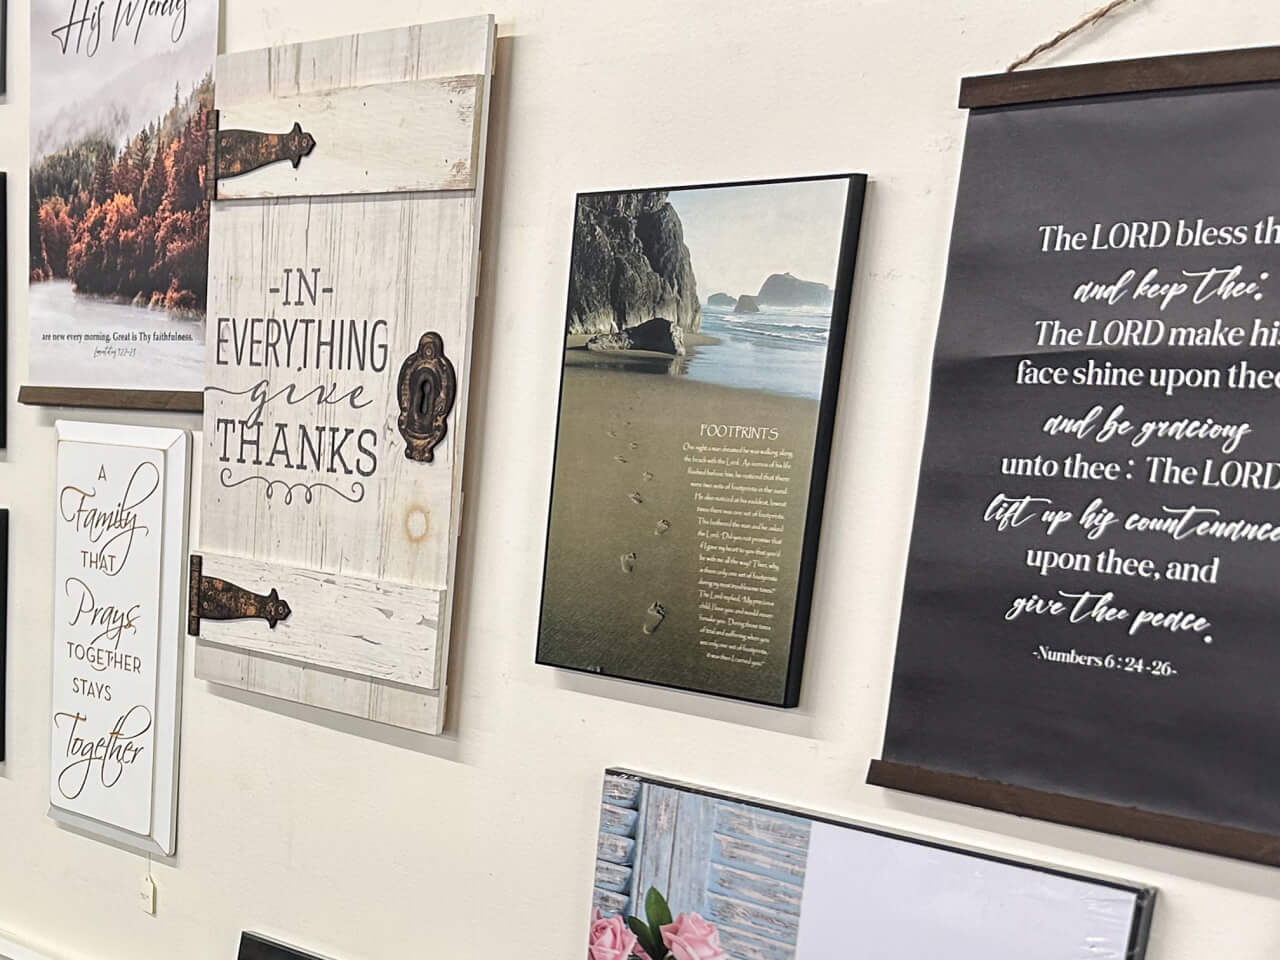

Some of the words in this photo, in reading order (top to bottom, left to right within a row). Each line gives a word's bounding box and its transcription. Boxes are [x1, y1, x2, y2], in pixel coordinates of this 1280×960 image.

[52, 0, 104, 57] His
[111, 0, 188, 45] Mercy
[1039, 225, 1087, 252] The
[1092, 220, 1171, 250] LORD
[1176, 219, 1248, 247] bless
[1073, 268, 1136, 305] and
[1133, 268, 1188, 312] keep
[41, 333, 52, 342] are
[52, 333, 65, 342] new
[66, 334, 83, 344] every
[112, 331, 131, 342] Great
[131, 332, 137, 342] is
[139, 332, 151, 344] Thy
[152, 331, 194, 342] faithfulness.
[215, 317, 389, 373] EVERYTHING
[1035, 320, 1083, 346] The
[1086, 319, 1165, 347] LORD
[1168, 318, 1245, 347] make
[1250, 318, 1280, 347] hi
[1016, 359, 1069, 385] face
[1072, 359, 1144, 386] shine
[1150, 365, 1220, 396] upon
[204, 379, 374, 430] give
[217, 418, 378, 477] THANKS
[700, 423, 780, 441] FOOTPRINTS
[1043, 405, 1104, 439] and
[1096, 405, 1134, 443] be
[1131, 418, 1252, 454] gracious
[97, 464, 108, 482] A
[1001, 454, 1059, 478] unto
[1147, 456, 1198, 485] The
[1202, 459, 1280, 490] LORD
[60, 461, 160, 574] Family
[984, 493, 1053, 531] lift
[1041, 509, 1072, 535] up
[1079, 498, 1120, 540] his
[80, 549, 117, 573] THAT
[1026, 549, 1091, 576] upon
[1096, 549, 1161, 581] thee,
[1166, 557, 1221, 584] and
[65, 577, 141, 664] Prays
[1005, 594, 1066, 620] give
[1128, 609, 1213, 644] peace.
[67, 641, 141, 676] TOGETHER
[72, 676, 112, 702] STAYS
[54, 704, 152, 800] Together
